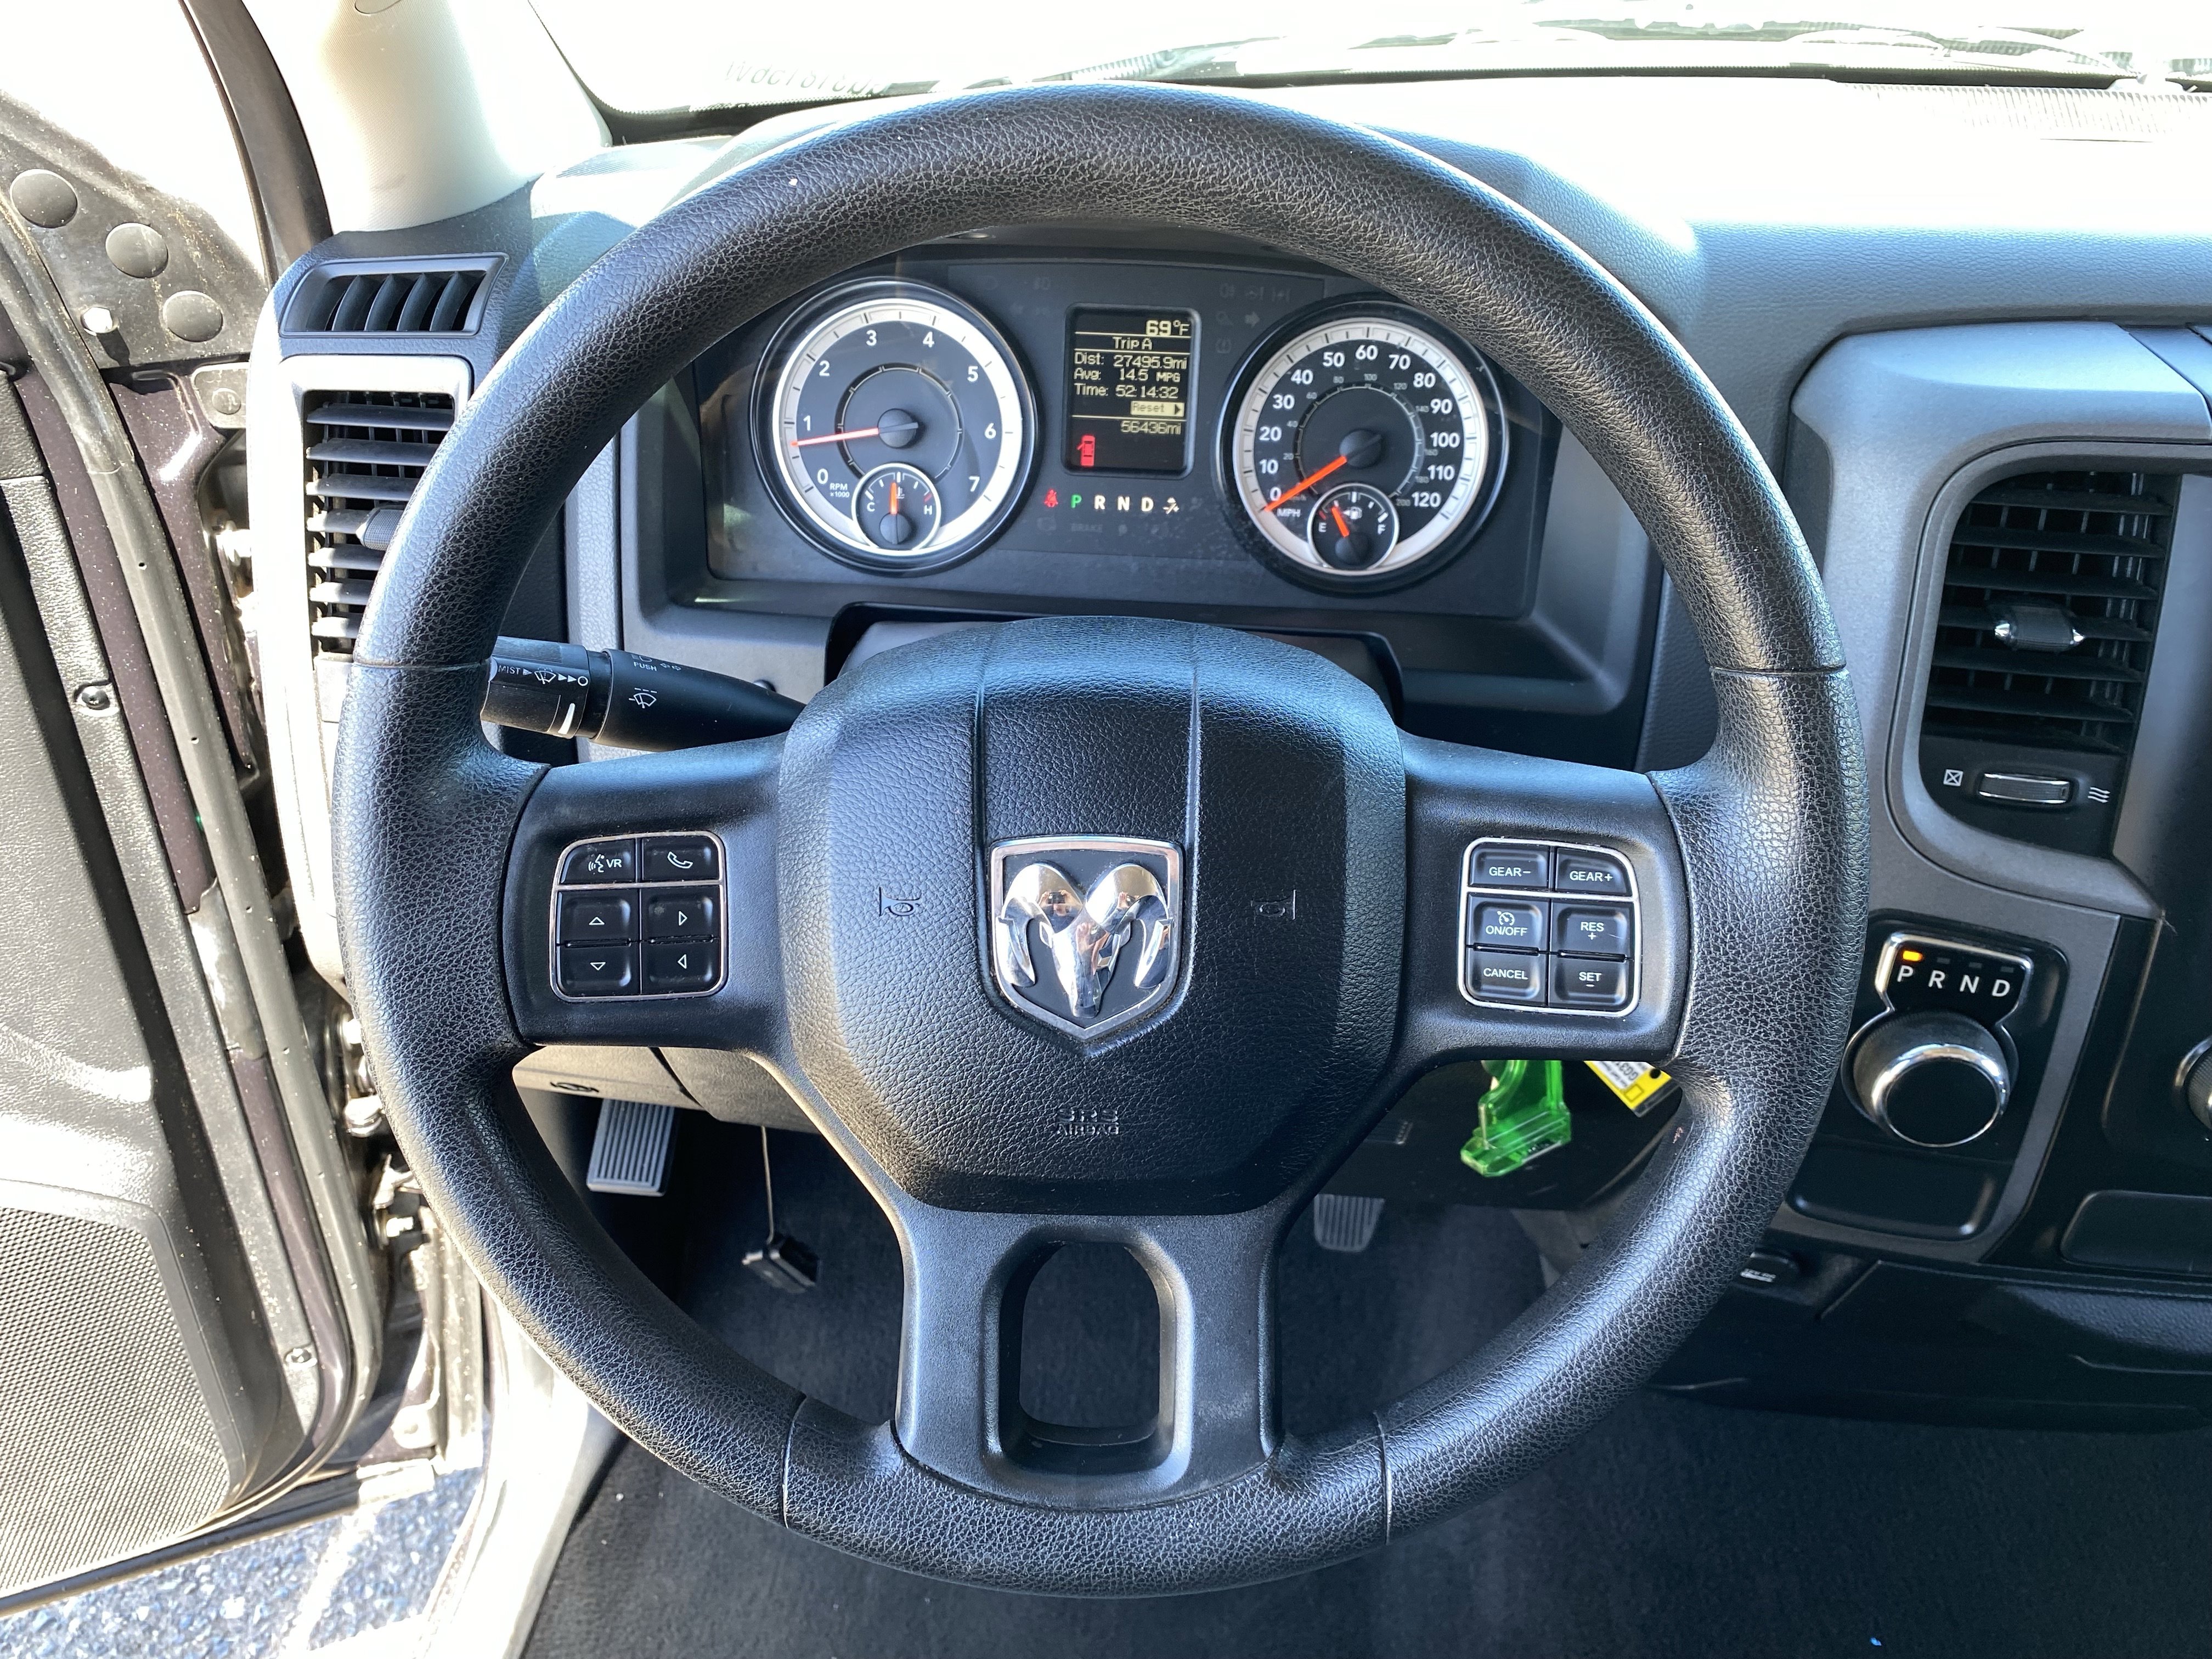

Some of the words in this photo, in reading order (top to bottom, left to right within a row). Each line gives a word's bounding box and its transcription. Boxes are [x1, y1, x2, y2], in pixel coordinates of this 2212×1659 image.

[866, 330, 877, 347] 3
[922, 332, 934, 347] 4
[1113, 337, 1139, 350] Trip
[1142, 337, 1152, 350] A
[1074, 352, 1104, 365] Dist:
[1355, 345, 1378, 360] 60
[1322, 352, 1345, 368] 50
[1389, 354, 1411, 370] 70
[819, 360, 830, 376] 2
[967, 366, 979, 381] 5
[1119, 369, 1149, 381] 14.5
[1156, 372, 1181, 382] MPG
[1290, 369, 1313, 385] 40
[1413, 372, 1436, 388] 80
[1074, 383, 1109, 397] Time:
[1132, 402, 1165, 413] Reset
[1272, 394, 1295, 410] 30
[1430, 398, 1453, 414] 90
[803, 415, 811, 431] 1
[984, 424, 997, 438] 6
[1259, 426, 1282, 442] 20
[1430, 432, 1460, 448] 100
[1260, 459, 1279, 475] 10
[1427, 465, 1455, 481] 110
[817, 469, 828, 484] 0
[830, 482, 848, 490] RPM
[969, 476, 980, 492] 7
[1269, 487, 1282, 501] 0
[1412, 492, 1441, 507] 120
[867, 502, 875, 512] C
[924, 505, 933, 515] H
[1071, 494, 1082, 509] P
[1094, 495, 1106, 510] R
[1117, 496, 1130, 511] N
[1141, 497, 1154, 512] D
[1277, 508, 1301, 517] MPH
[1319, 522, 1327, 533] E
[1378, 524, 1386, 535] F
[498, 665, 521, 675] MIST
[633, 661, 657, 672] PUSH
[606, 859, 622, 868] VR
[1570, 871, 1613, 882] GEAR+
[1486, 926, 1528, 936] ON/OFF
[1580, 921, 1604, 932] RES
[1483, 968, 1528, 980] CANCEL
[1579, 972, 1602, 981] SET
[1897, 965, 1914, 982] P
[1928, 970, 1945, 989] R
[1959, 974, 1980, 994] N
[1991, 979, 2011, 997] D
